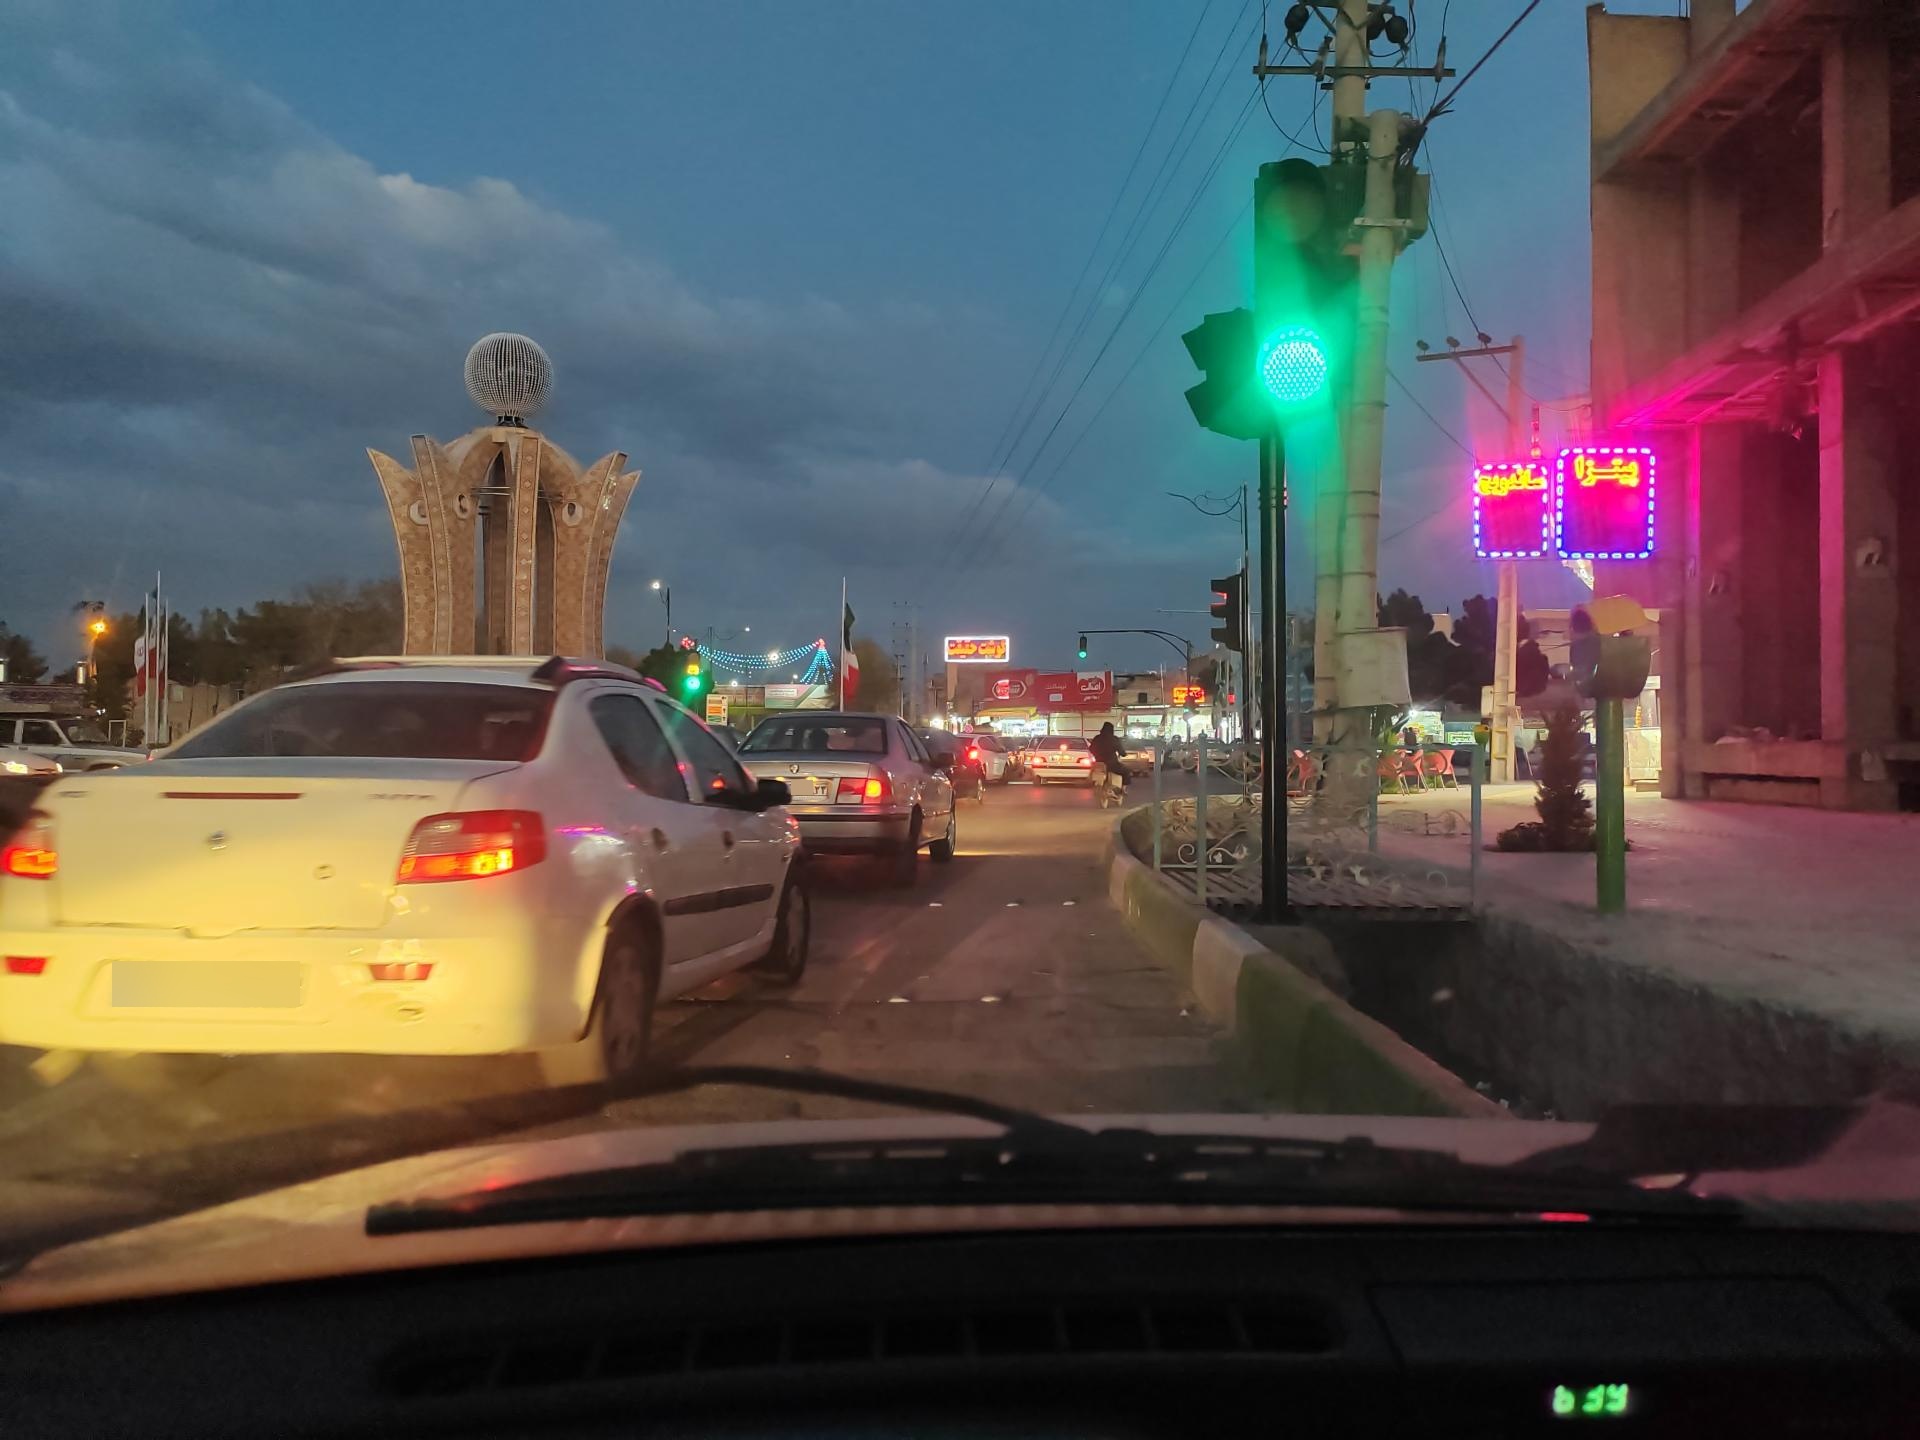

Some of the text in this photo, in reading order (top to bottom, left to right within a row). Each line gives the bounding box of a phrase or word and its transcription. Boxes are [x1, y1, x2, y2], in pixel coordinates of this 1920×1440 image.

[1478, 467, 1546, 496] ساندویچ
[1574, 454, 1640, 488] پیتزا
[947, 639, 1006, 659] گوشت حقیقت
